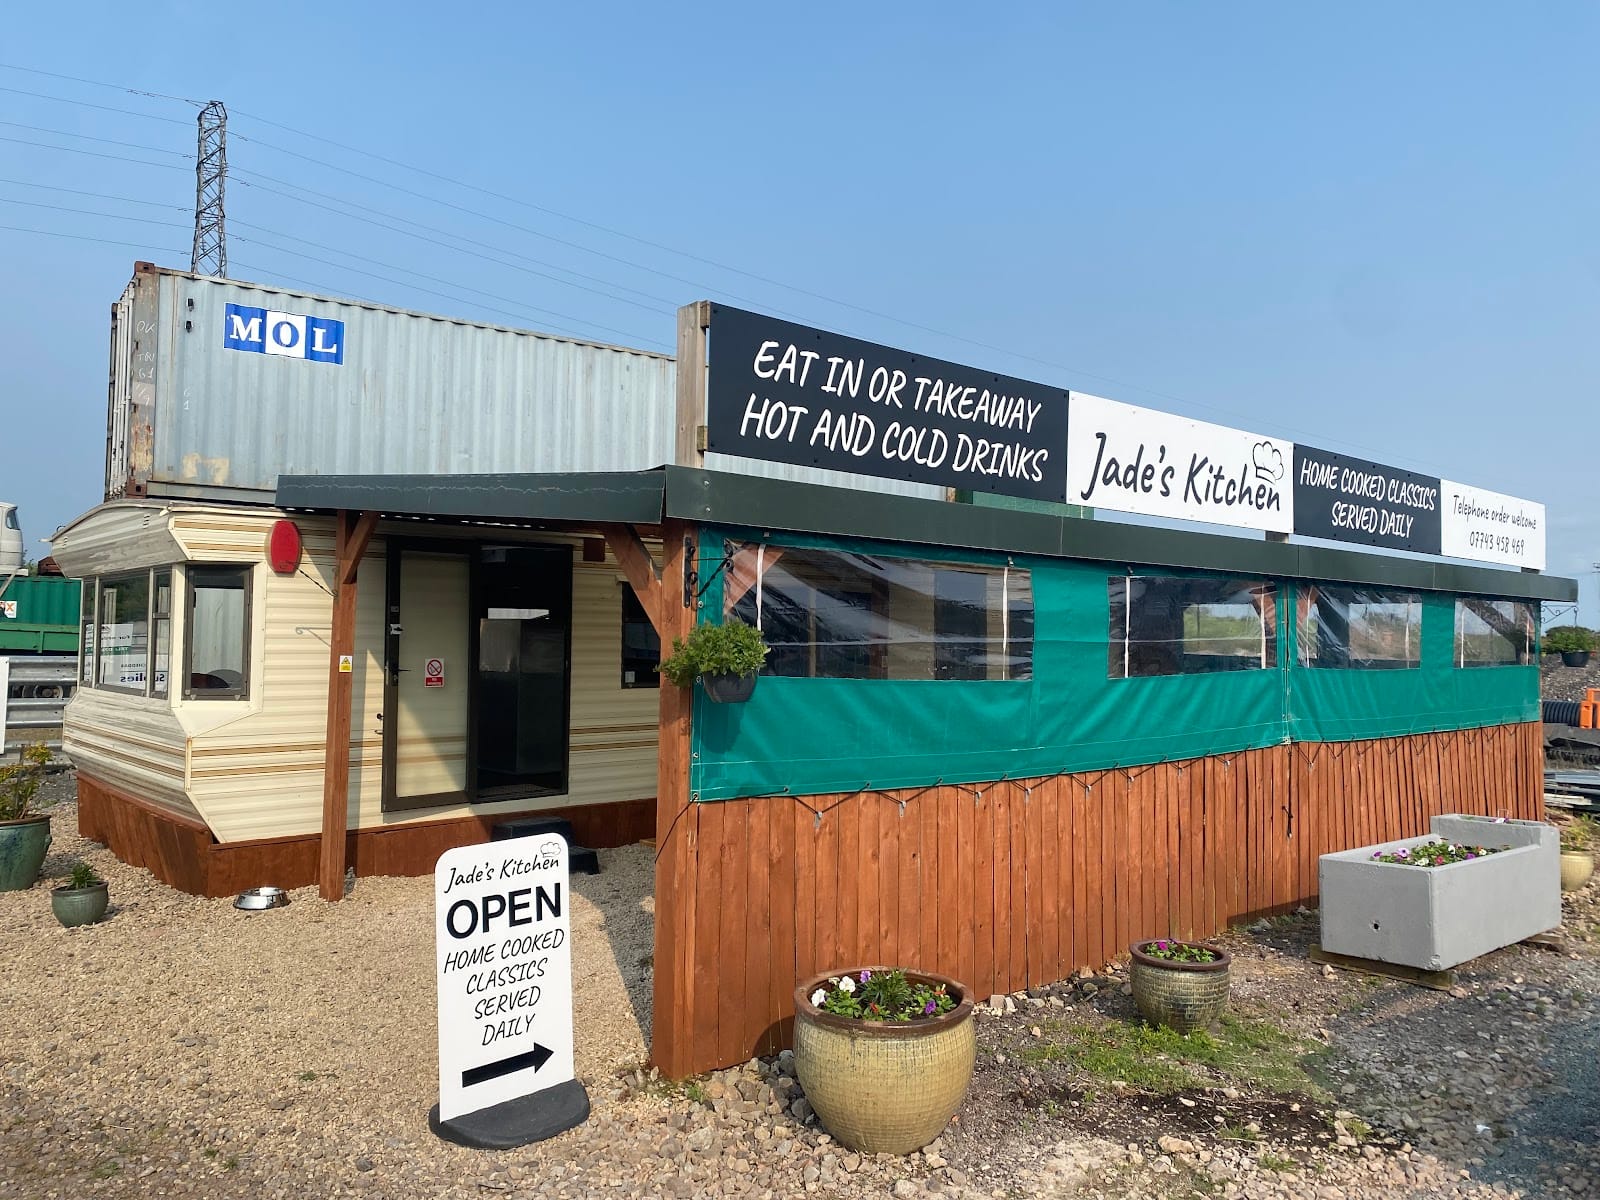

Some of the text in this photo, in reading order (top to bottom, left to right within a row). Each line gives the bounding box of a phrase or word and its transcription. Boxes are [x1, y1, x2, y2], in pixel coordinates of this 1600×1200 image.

[229, 314, 337, 354] MOL
[753, 341, 1042, 433] EAT IN OR TAKEAWAY
[740, 394, 1049, 482] HOT AND COLD DRINKS
[1080, 432, 1281, 511] Jade's Kitchen
[1300, 458, 1437, 511] HOME COOKED CLASSICS
[1331, 501, 1414, 538] SERVED DAILY
[1453, 494, 1537, 530] Telephone order welcome
[1469, 531, 1525, 556] 07743 458 469
[444, 854, 560, 894] Jade's Kitchen
[446, 882, 561, 939] OPEN
[444, 928, 565, 974] HOME COOKED
[466, 957, 549, 995] CLASSICS
[474, 986, 542, 1019] SERVED
[482, 1013, 536, 1046] DAILY
